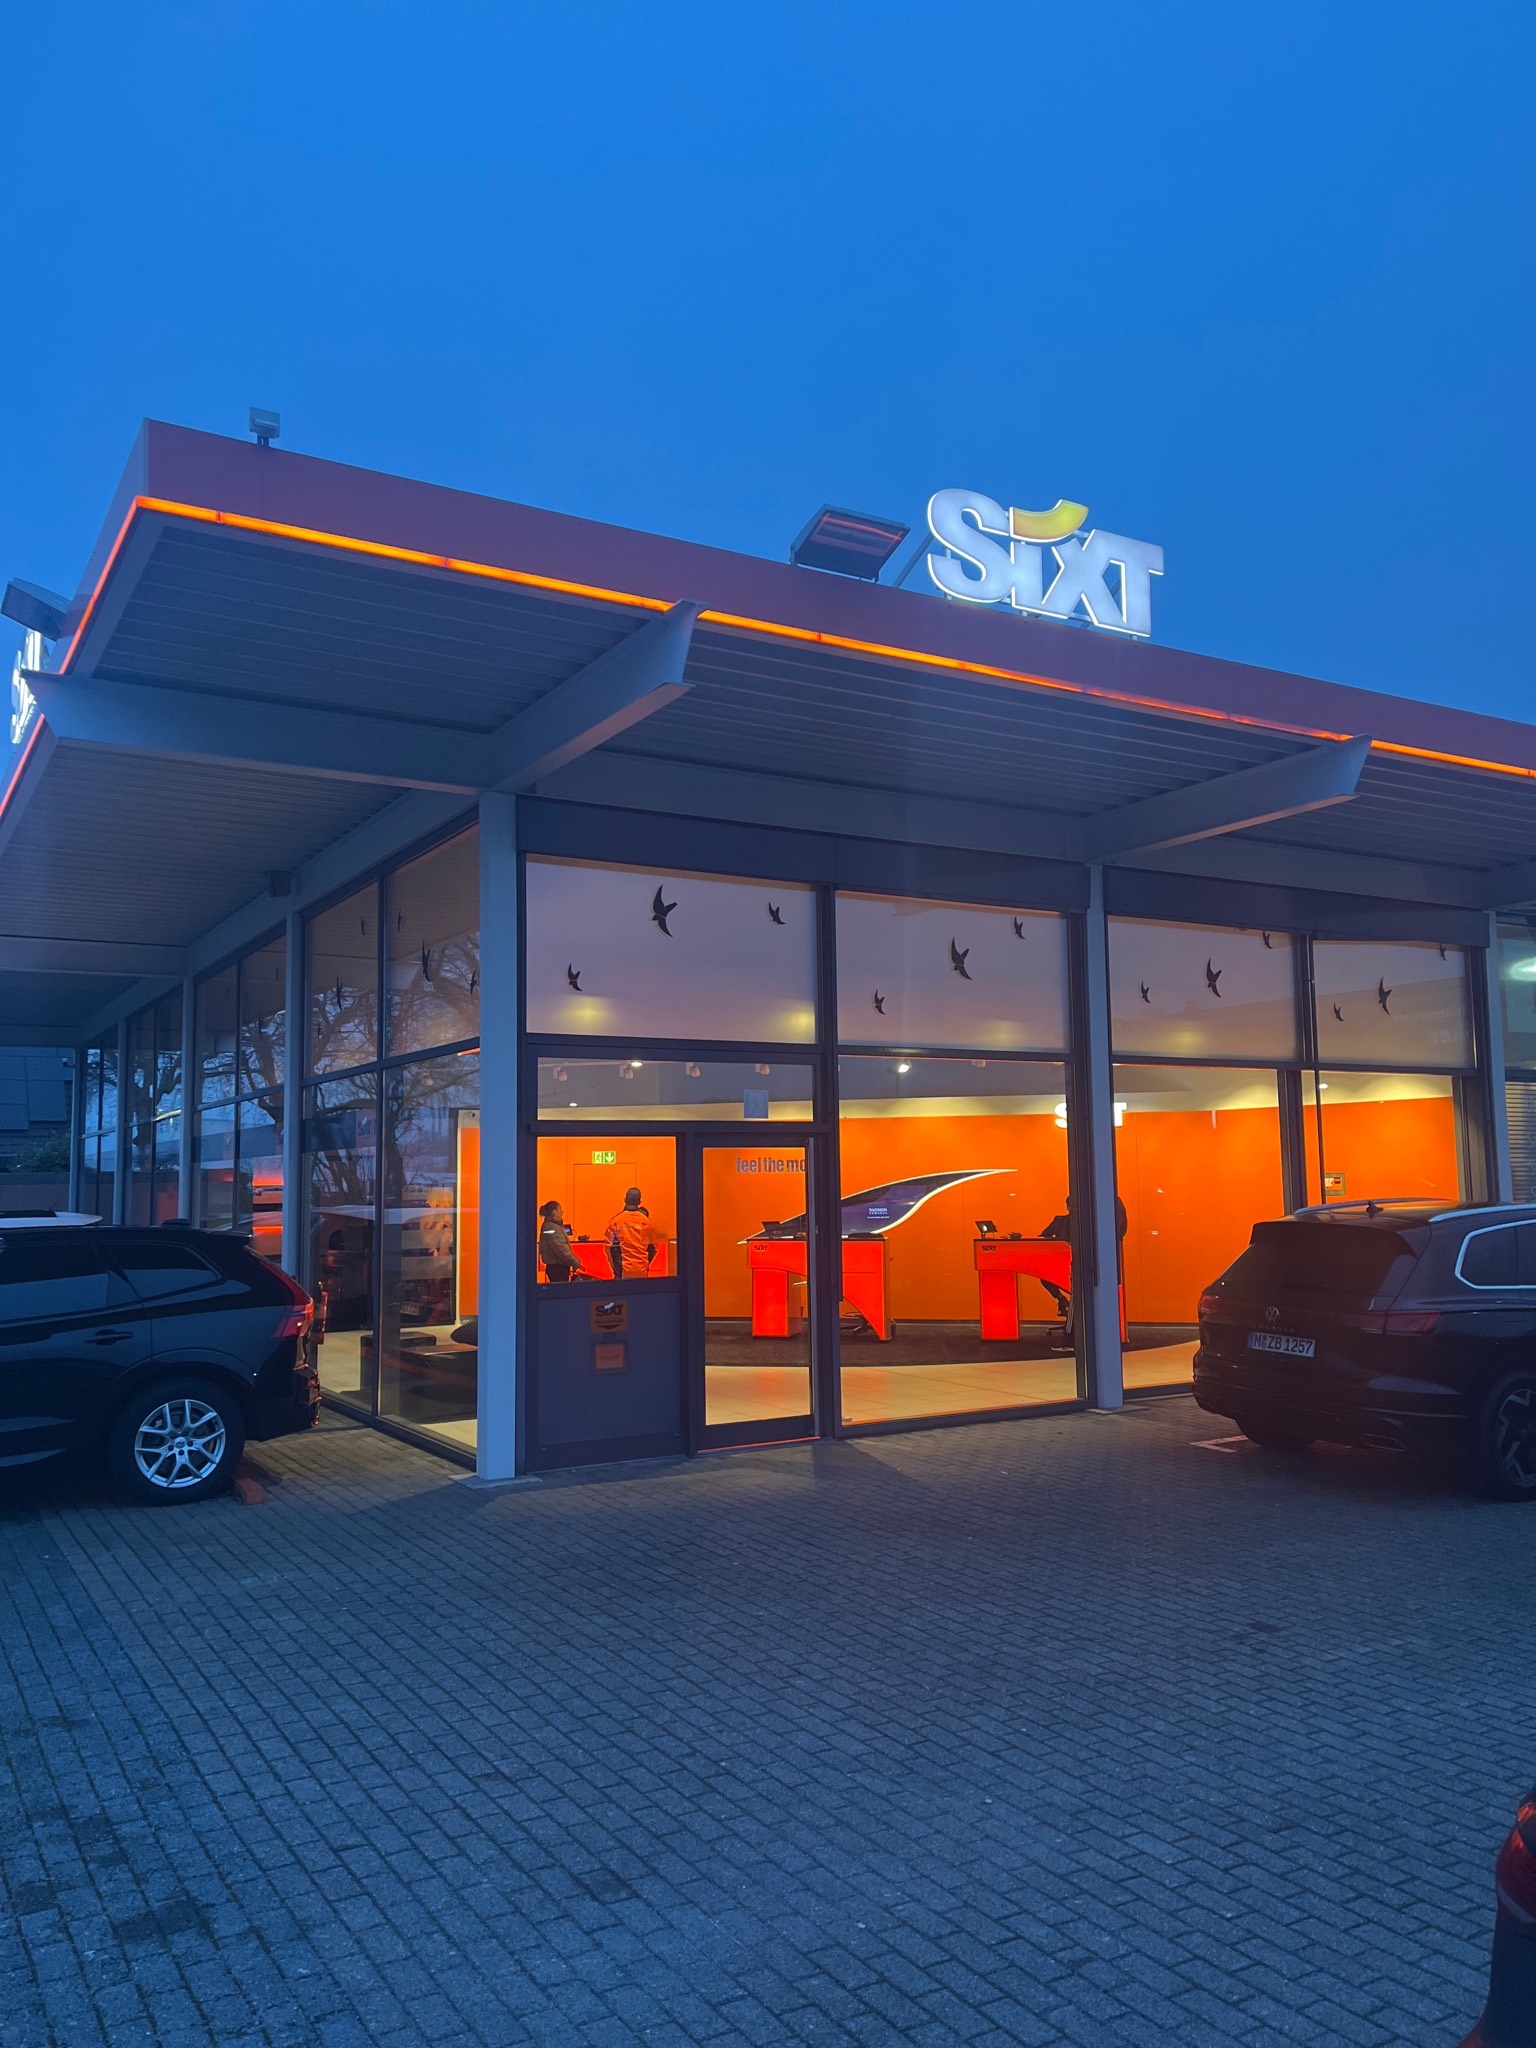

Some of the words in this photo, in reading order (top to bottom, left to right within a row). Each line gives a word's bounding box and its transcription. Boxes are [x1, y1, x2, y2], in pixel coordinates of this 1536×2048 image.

[927, 488, 1165, 637] SIXT
[736, 1157, 761, 1173] feel
[763, 1157, 784, 1173] the
[1253, 1333, 1262, 1348] M
[1267, 1335, 1283, 1350] ZB
[1284, 1337, 1314, 1355] 1257
